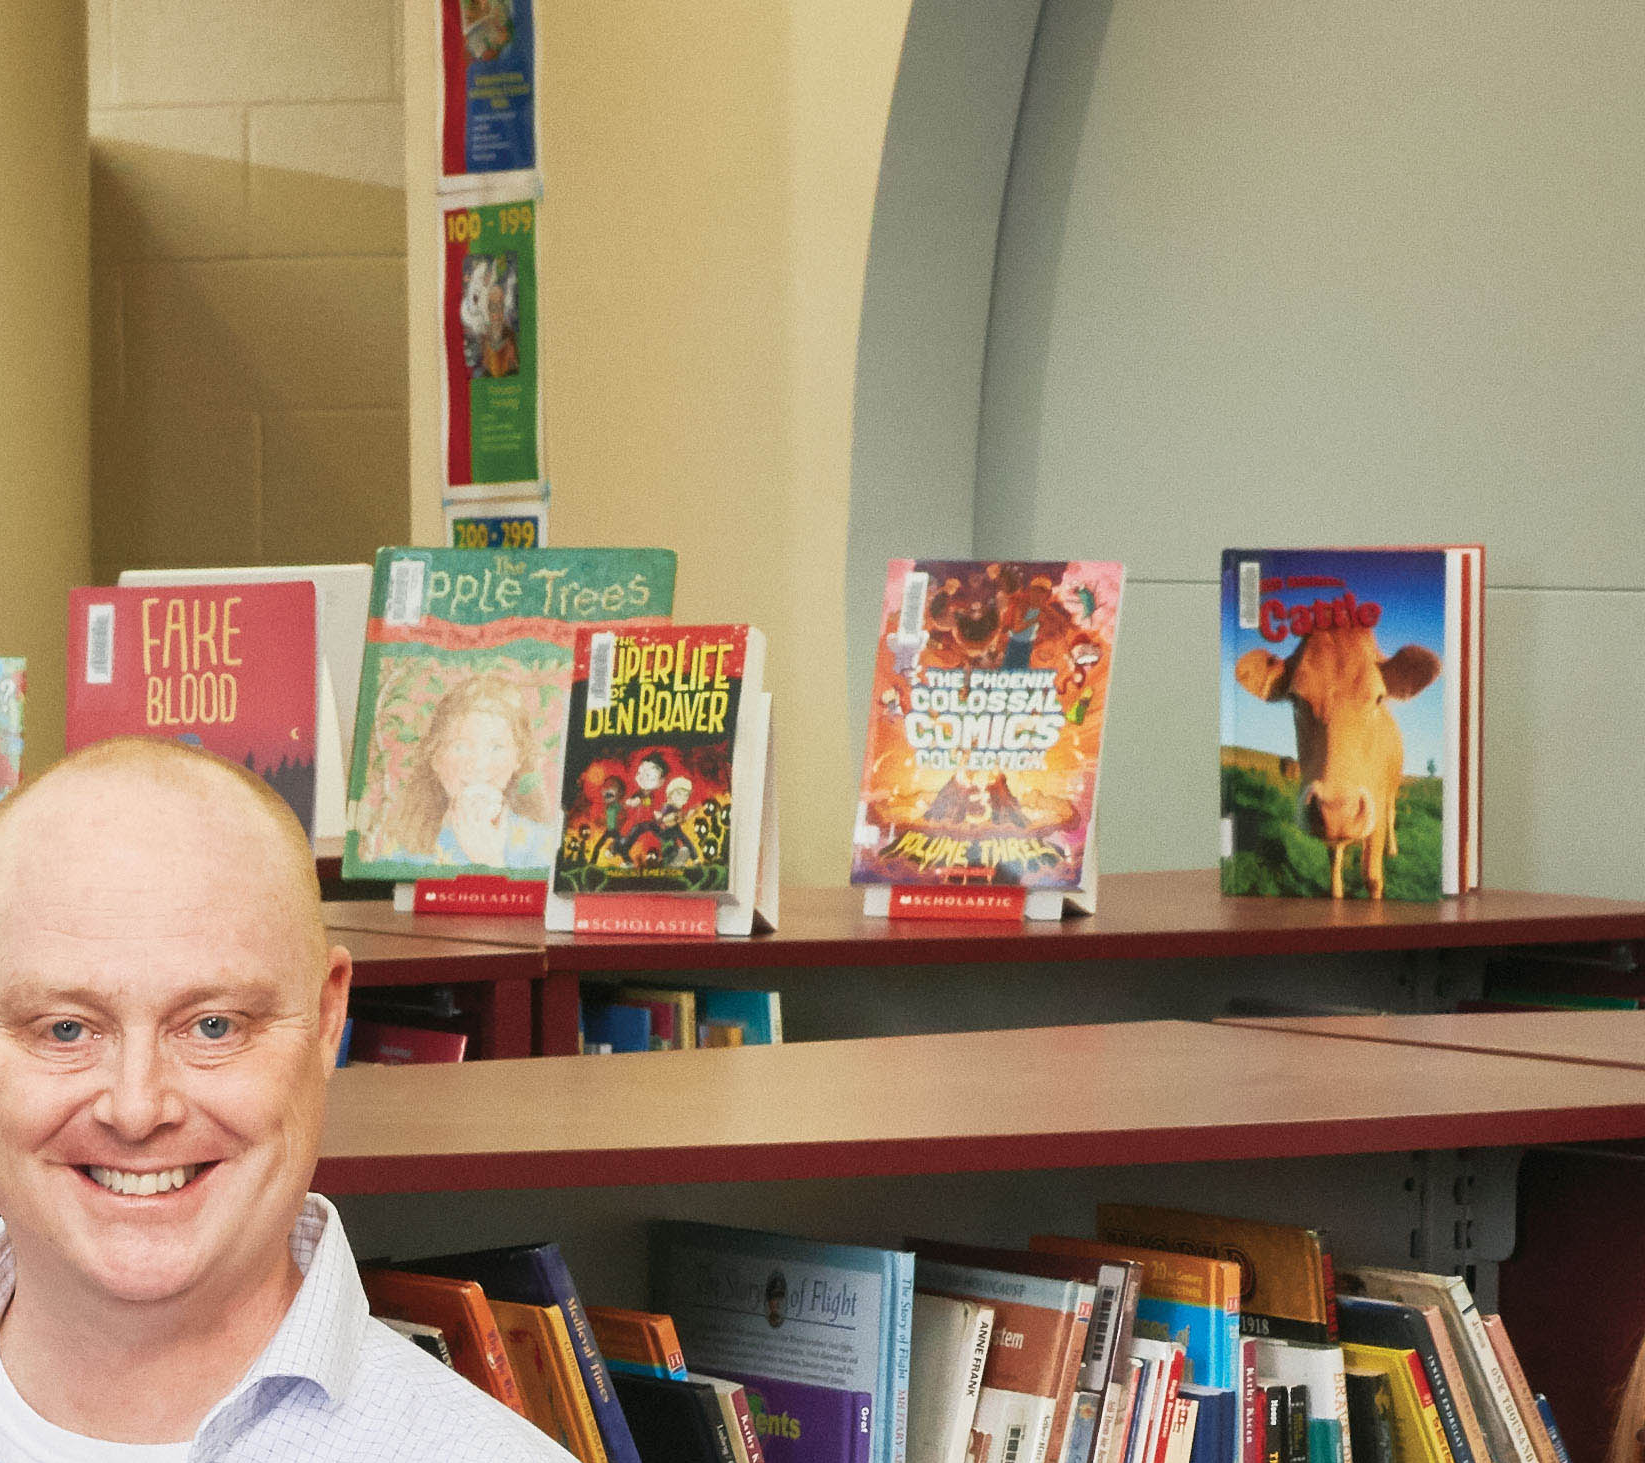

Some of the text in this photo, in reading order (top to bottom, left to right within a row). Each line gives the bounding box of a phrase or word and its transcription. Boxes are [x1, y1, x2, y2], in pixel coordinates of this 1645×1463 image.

[427, 568, 650, 617] pple Trees
[1260, 591, 1382, 643] Cattle
[141, 596, 242, 677] FAKE
[611, 639, 734, 691] UPER LIFE
[146, 672, 238, 727] BLOOD
[637, 684, 729, 736] BRAVER
[909, 687, 1063, 713] COLOSSAL
[904, 712, 1066, 750] COMICS
[438, 891, 533, 904] SCHOLASTIC
[913, 896, 1013, 907] SCHOLASTIC
[591, 917, 710, 934] SCHOLASTIC
[807, 1280, 857, 1322] Flight
[566, 1296, 596, 1361] Medieval
[588, 1361, 610, 1404] Times
[965, 1320, 990, 1397] ANNE FRANK
